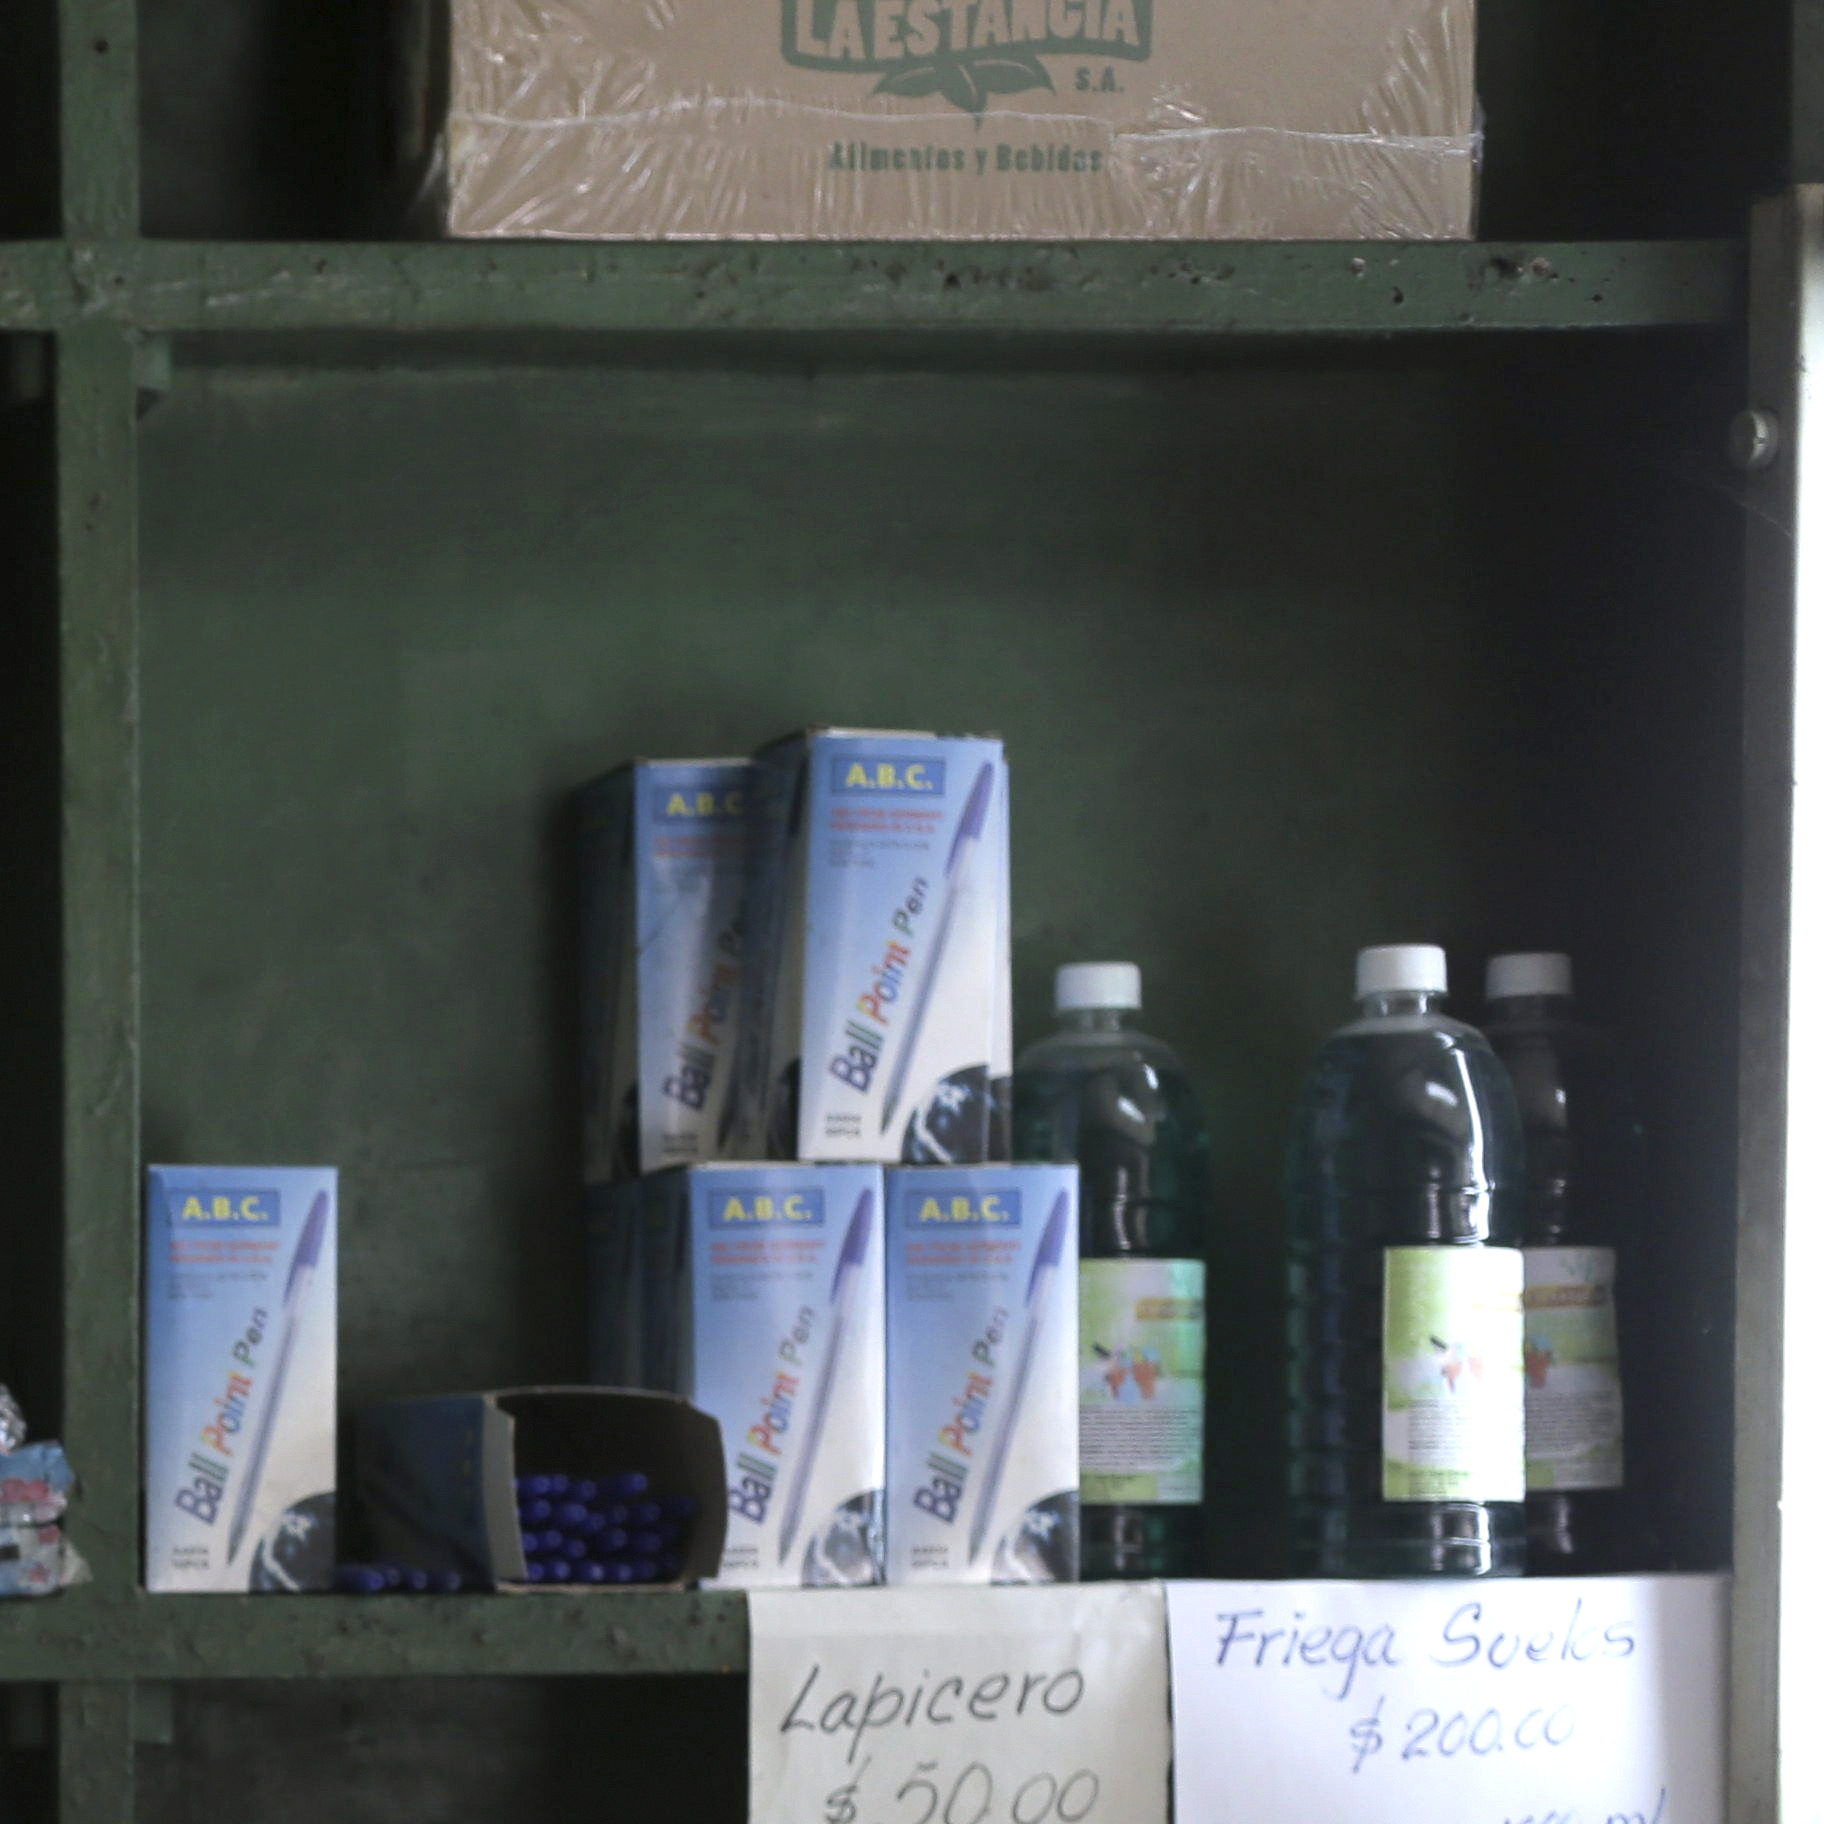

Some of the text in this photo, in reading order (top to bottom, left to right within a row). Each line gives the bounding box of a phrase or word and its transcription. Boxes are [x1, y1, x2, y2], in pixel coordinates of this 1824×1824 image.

[1076, 65, 1125, 93] S.A.
[828, 141, 1105, 176] Alimentos y Bebidas
[846, 763, 934, 790] A.B.C.
[893, 876, 929, 937] Pen
[856, 937, 913, 1027] Point
[828, 1018, 885, 1093] Ball
[182, 1196, 268, 1222] A.B.C.
[723, 1196, 811, 1222] A.B.C.
[919, 1196, 1009, 1222] A.B.C.
[778, 1305, 818, 1367] Pen
[971, 1306, 1009, 1369] Pen
[174, 1451, 229, 1527] Ball
[202, 1369, 256, 1459] Point
[233, 1307, 269, 1368] Pen
[747, 1369, 800, 1456] Point
[937, 1369, 995, 1459] Point
[728, 1451, 779, 1526] Ball
[913, 1450, 968, 1526] Ball
[1217, 1609, 1398, 1701] Friega
[781, 1664, 1085, 1765] Lapicero
